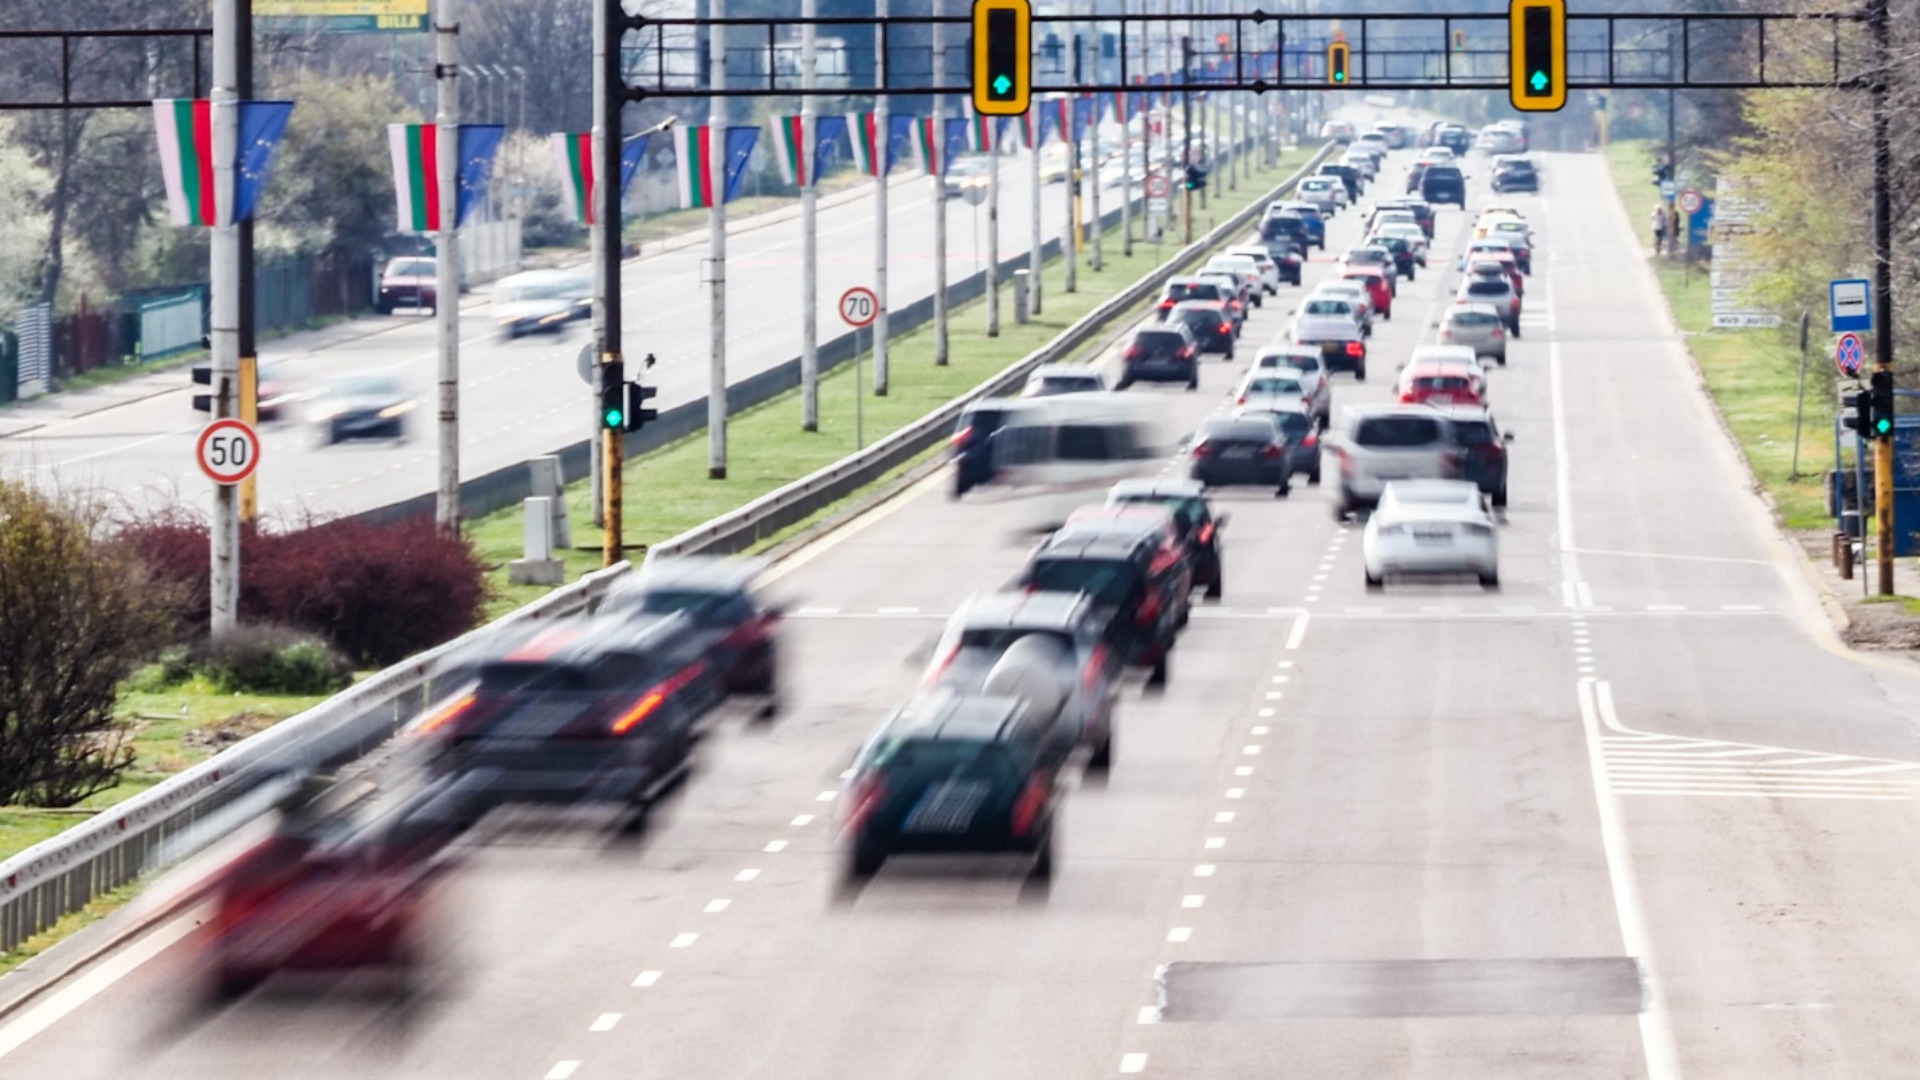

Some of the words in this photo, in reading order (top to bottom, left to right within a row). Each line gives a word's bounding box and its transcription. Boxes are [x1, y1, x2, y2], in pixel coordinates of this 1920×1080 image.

[376, 15, 420, 29] BILLA
[848, 297, 870, 317] 70
[211, 436, 246, 466] 50
